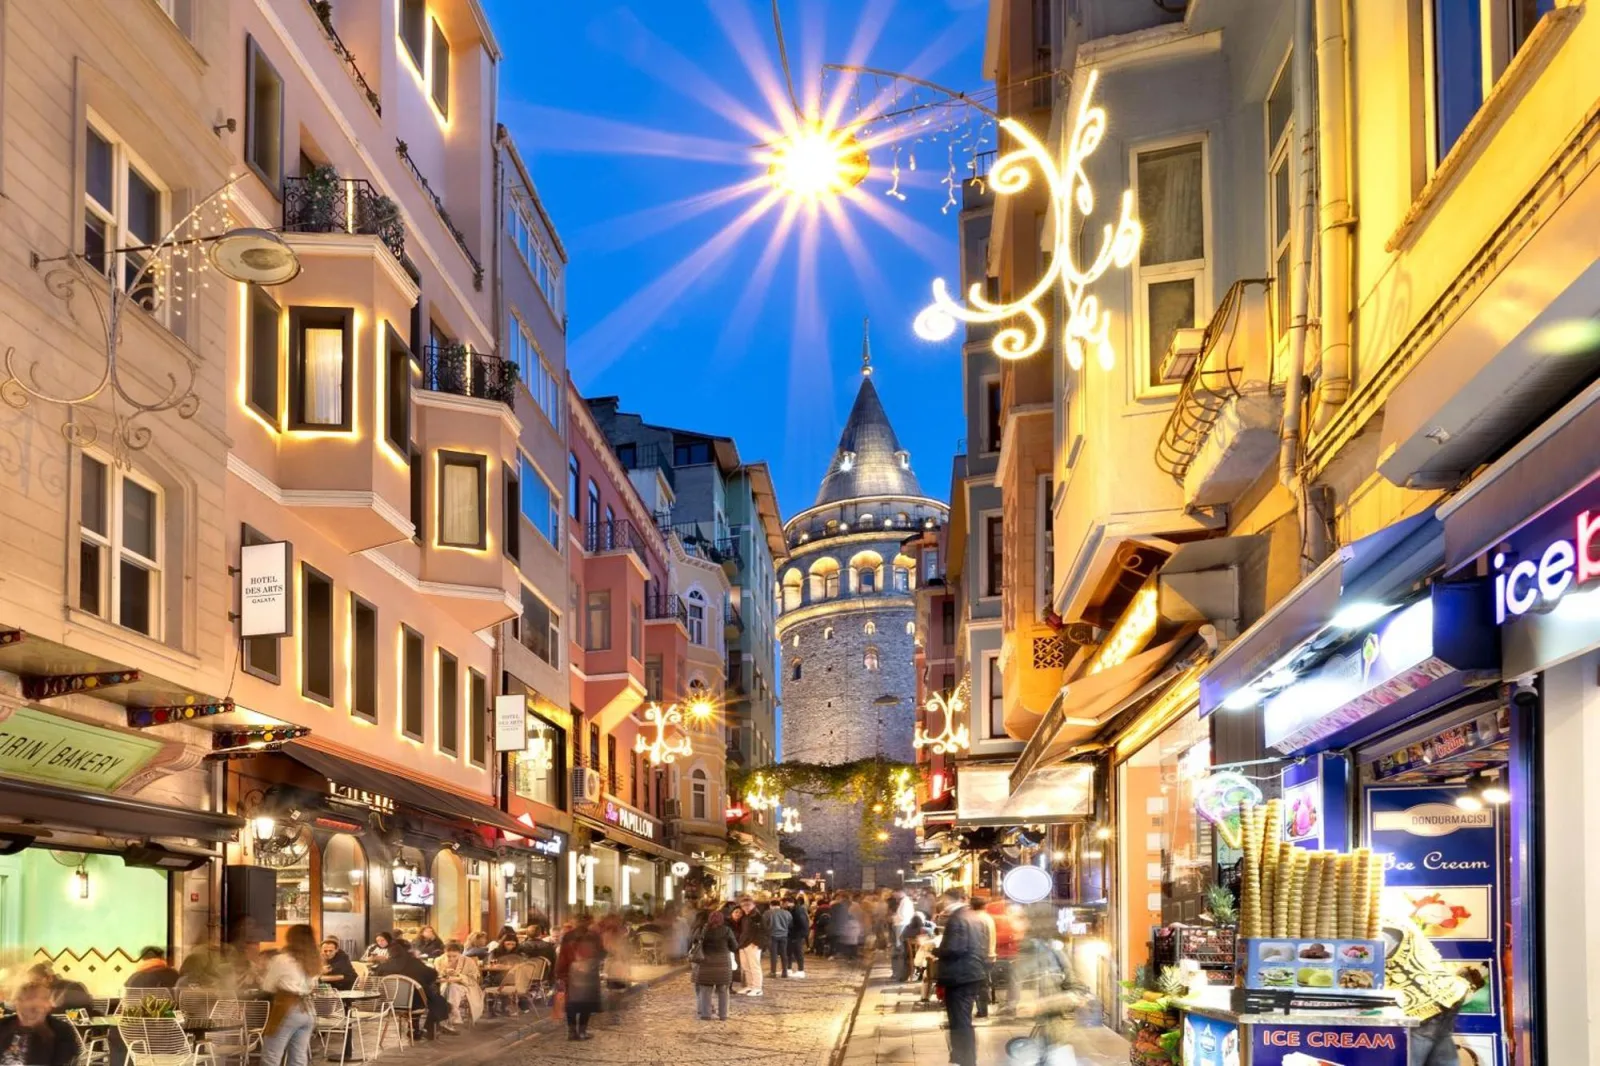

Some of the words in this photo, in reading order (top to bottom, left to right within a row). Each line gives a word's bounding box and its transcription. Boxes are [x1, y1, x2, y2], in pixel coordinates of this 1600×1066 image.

[245, 586, 261, 595] DES
[262, 584, 283, 594] ARTS
[250, 575, 278, 585] HOTEL
[48, 746, 124, 775] BAKERY
[618, 807, 654, 839] PAPILLON
[1423, 851, 1490, 870] Cream
[1263, 1030, 1301, 1047] ICE
[1306, 1031, 1396, 1050] CREAM
